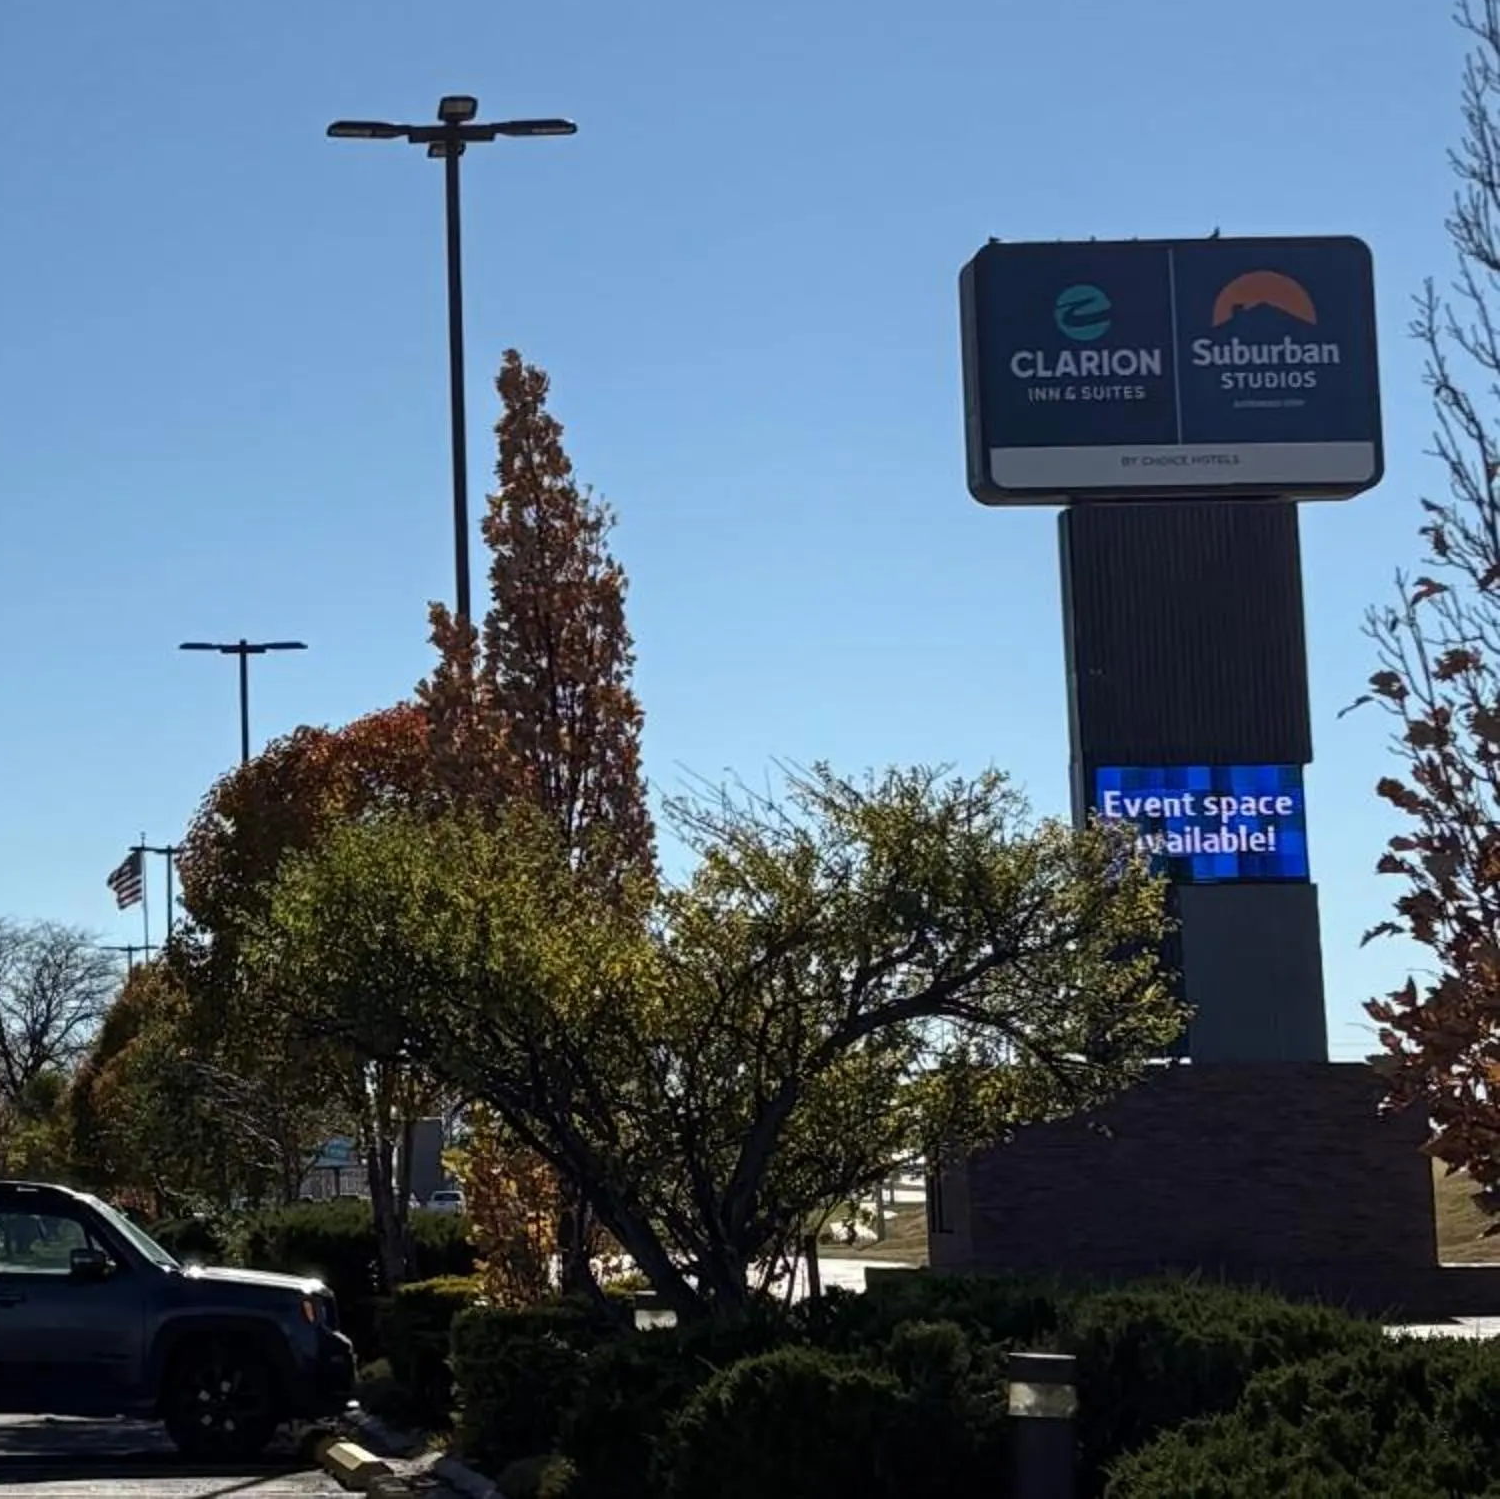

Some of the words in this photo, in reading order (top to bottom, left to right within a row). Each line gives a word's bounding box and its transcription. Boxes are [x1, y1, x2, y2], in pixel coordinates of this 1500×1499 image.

[1011, 349, 1162, 378] CLARION
[1192, 335, 1341, 366] Suburban
[1028, 387, 1061, 403] INN
[1064, 386, 1077, 400] &
[1081, 385, 1146, 400] SUITES
[1220, 370, 1318, 389] STUDIOS
[1103, 790, 1197, 818] Event
[1203, 795, 1293, 823] space
[1133, 824, 1276, 854] vailable!
